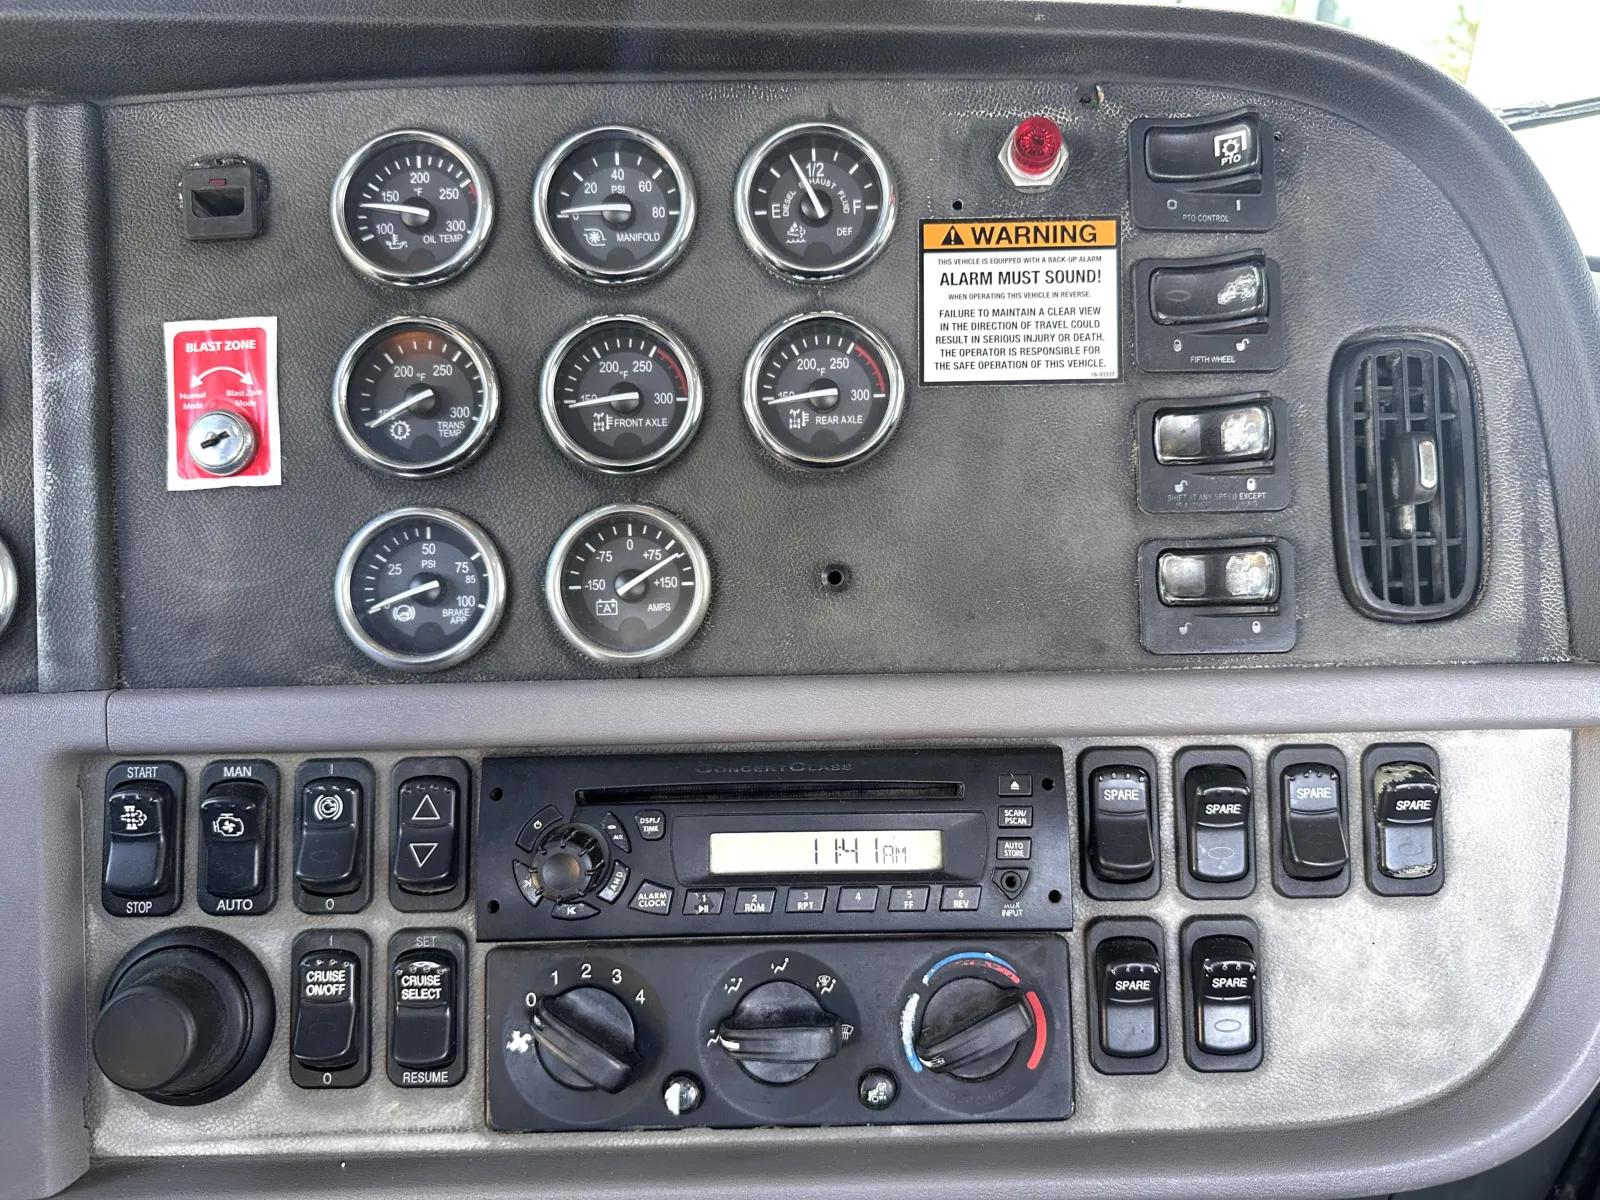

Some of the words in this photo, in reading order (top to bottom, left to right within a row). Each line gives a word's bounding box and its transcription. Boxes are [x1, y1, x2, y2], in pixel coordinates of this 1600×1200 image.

[1221, 154, 1241, 165] PTO
[611, 169, 624, 181] 40
[806, 162, 824, 177] 1/2
[410, 172, 430, 184] 200
[584, 182, 598, 193] 20
[611, 185, 626, 194] PSI
[638, 181, 652, 192] 60
[382, 191, 400, 202] 150
[440, 188, 459, 200] 250
[782, 190, 797, 217] DIESEL
[837, 190, 849, 213] FLUID
[852, 200, 861, 214] F
[652, 207, 666, 218] 80
[772, 204, 781, 218] E
[376, 224, 394, 235] 100
[446, 221, 466, 232] 300
[837, 227, 852, 236] DEF
[423, 235, 438, 244] OIL
[440, 233, 463, 243] TEMP
[616, 233, 660, 242] MANIFOLD
[971, 224, 1097, 245] WARNING
[940, 272, 993, 286] ALARM
[998, 271, 1040, 285] MUST
[1045, 269, 1101, 284] SOUND!
[939, 309, 976, 318] FAILURE
[978, 309, 989, 317] TO
[992, 308, 1036, 317] MAINTAIN
[1038, 308, 1045, 316] A
[1047, 307, 1076, 316] CLEAR
[1079, 307, 1101, 315] VIEW
[940, 323, 949, 331] IN
[952, 322, 968, 330] THE
[971, 322, 1018, 330] DIRECTION
[1020, 321, 1032, 329] OF
[1034, 321, 1068, 329] TRAVEL
[1071, 320, 1100, 329] COULD
[935, 336, 968, 344] RESULT
[971, 335, 980, 343] IN
[983, 335, 1021, 343] SERIOUS
[1023, 334, 1055, 343] INJURY
[1058, 334, 1071, 342] OR
[1073, 333, 1104, 342] DEATH.
[185, 341, 222, 353] BLAST
[224, 340, 256, 351] ZONE
[940, 349, 957, 357] THE
[959, 348, 1006, 356] OPERATOR
[1008, 348, 1017, 356] IS
[1019, 347, 1081, 356] RESPONSIBLE
[1083, 346, 1100, 354] FOR
[599, 361, 619, 373] 200
[632, 361, 652, 372] 250
[797, 358, 816, 370] 200
[830, 358, 849, 369] 250
[935, 362, 951, 370] THE
[953, 362, 975, 370] SAFE
[978, 361, 1028, 369] OPERATION
[1030, 360, 1042, 368] OF
[1045, 360, 1065, 368] THIS
[1067, 359, 1106, 367] VEHICLE.
[393, 366, 413, 378] 200
[433, 364, 453, 376] 250
[179, 392, 206, 400] Normal
[654, 393, 673, 404] 300
[851, 389, 870, 401] 300
[450, 407, 470, 418] 300
[437, 421, 465, 430] TRANS
[614, 418, 643, 427] FRONT
[645, 418, 668, 426] AXLE
[815, 416, 838, 425] REAR
[841, 415, 863, 424] AXLE
[439, 428, 462, 438] TEMP
[1240, 492, 1266, 500] EXCEPT
[422, 544, 436, 555] 50
[626, 539, 633, 551] 0
[595, 551, 613, 562] -75
[642, 549, 662, 561] +75
[388, 564, 402, 575] 25
[421, 560, 436, 568] PSI
[455, 562, 469, 573] 75
[584, 579, 606, 591] -150
[653, 577, 678, 588] +150
[456, 596, 475, 607] 100
[442, 609, 470, 617] BRAKE
[647, 603, 671, 612] AMPS
[450, 616, 466, 625] APP
[127, 767, 158, 778] START
[224, 767, 252, 777] MAN
[1104, 789, 1139, 801] SPARE
[1296, 788, 1332, 799] SPARE
[1205, 804, 1242, 815] SPARE
[1395, 800, 1431, 812] SPARE
[1004, 809, 1026, 817] SCAN/
[1004, 817, 1027, 825] PSCAN
[642, 825, 658, 833] TIME
[814, 837, 878, 864] 11:41
[1004, 842, 1024, 850] AUTO
[1004, 849, 1025, 857] STORE
[638, 892, 667, 900] ALARM
[751, 894, 757, 902] 2
[803, 891, 809, 900] 3
[855, 892, 862, 900] 4
[906, 891, 912, 899] 5
[958, 889, 964, 898] 6
[126, 902, 152, 913] STOP
[217, 899, 253, 910] AUTO
[639, 899, 666, 907] CLOCK
[797, 901, 814, 910] RPT
[904, 900, 914, 909] FF
[953, 899, 969, 908] REV
[1002, 909, 1023, 917] INPUT
[416, 936, 438, 947] SET
[306, 970, 346, 983] CRUISE
[581, 963, 592, 979] 2
[611, 969, 622, 984] 3
[401, 974, 440, 987] CRUISE
[551, 971, 559, 985] 1
[1212, 977, 1247, 988] SPARE
[306, 983, 346, 996] ON/OFF
[1115, 980, 1150, 991] SPARE
[402, 987, 442, 1000] SELECT
[635, 989, 645, 1004] 4
[525, 992, 536, 1007] 0
[403, 1072, 448, 1084] RESUME
